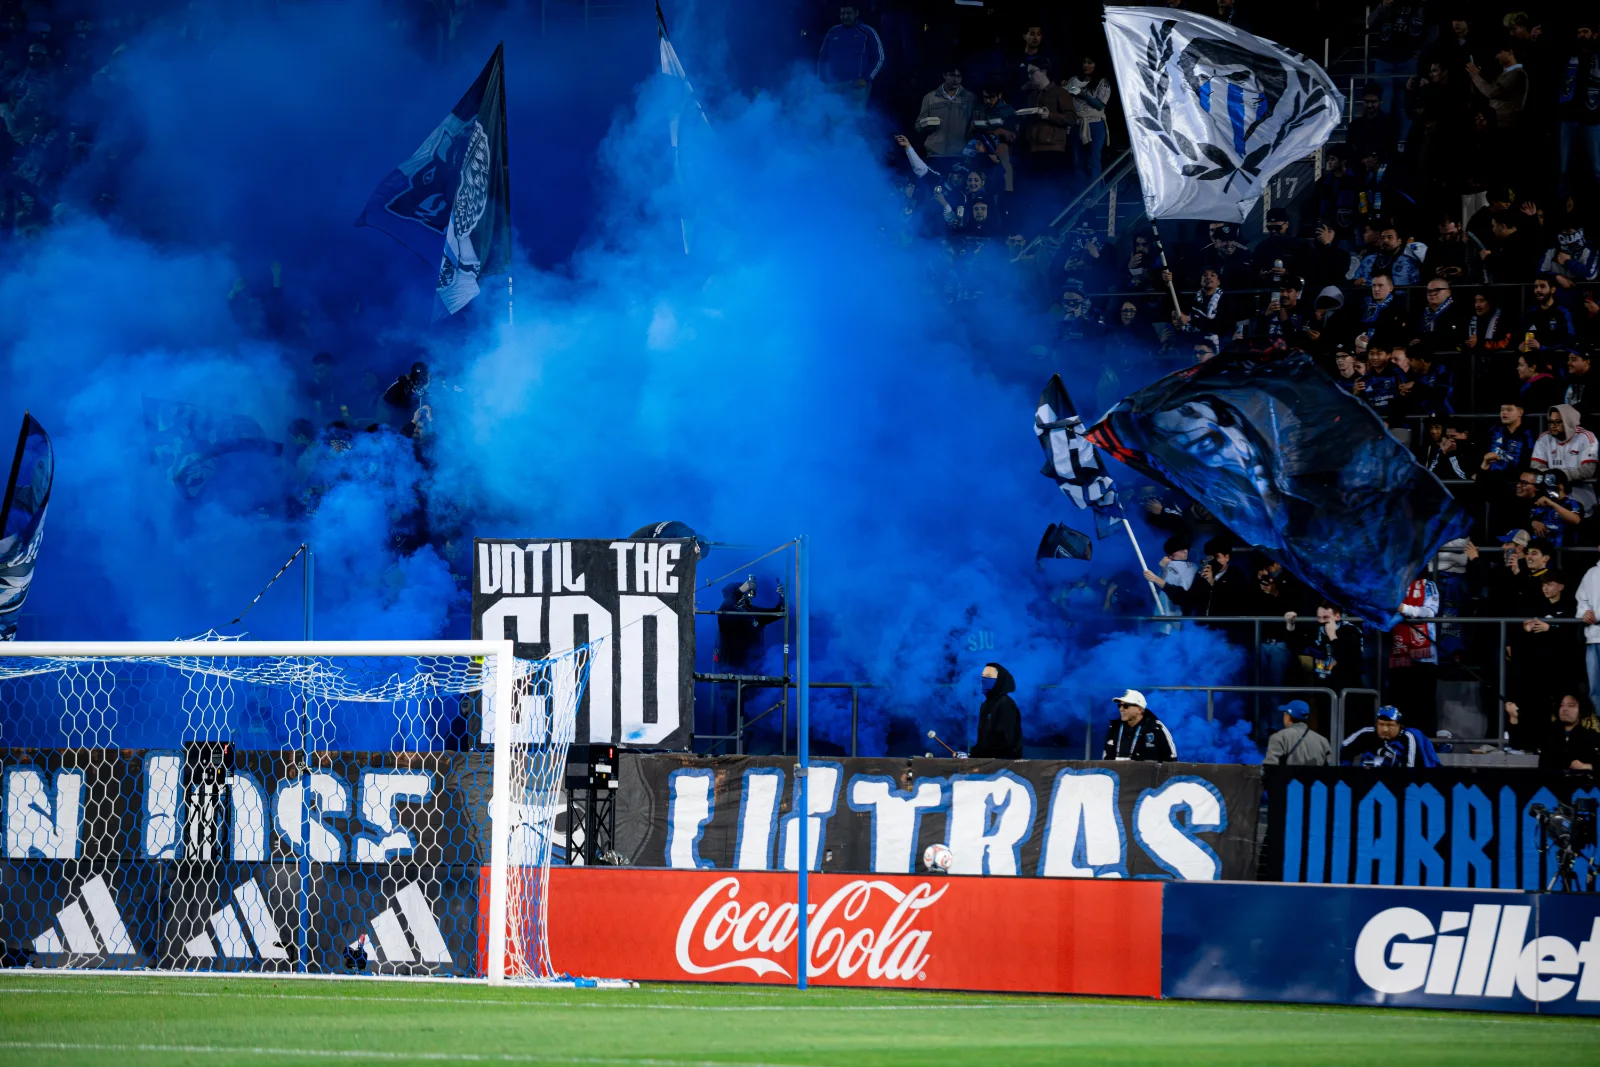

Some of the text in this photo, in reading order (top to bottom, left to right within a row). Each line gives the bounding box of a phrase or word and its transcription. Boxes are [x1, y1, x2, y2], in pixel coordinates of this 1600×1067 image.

[478, 541, 681, 594] UNTIL THE
[480, 595, 680, 744] END
[664, 759, 1228, 882] ULTRAS
[675, 876, 949, 981] Coca-Cola
